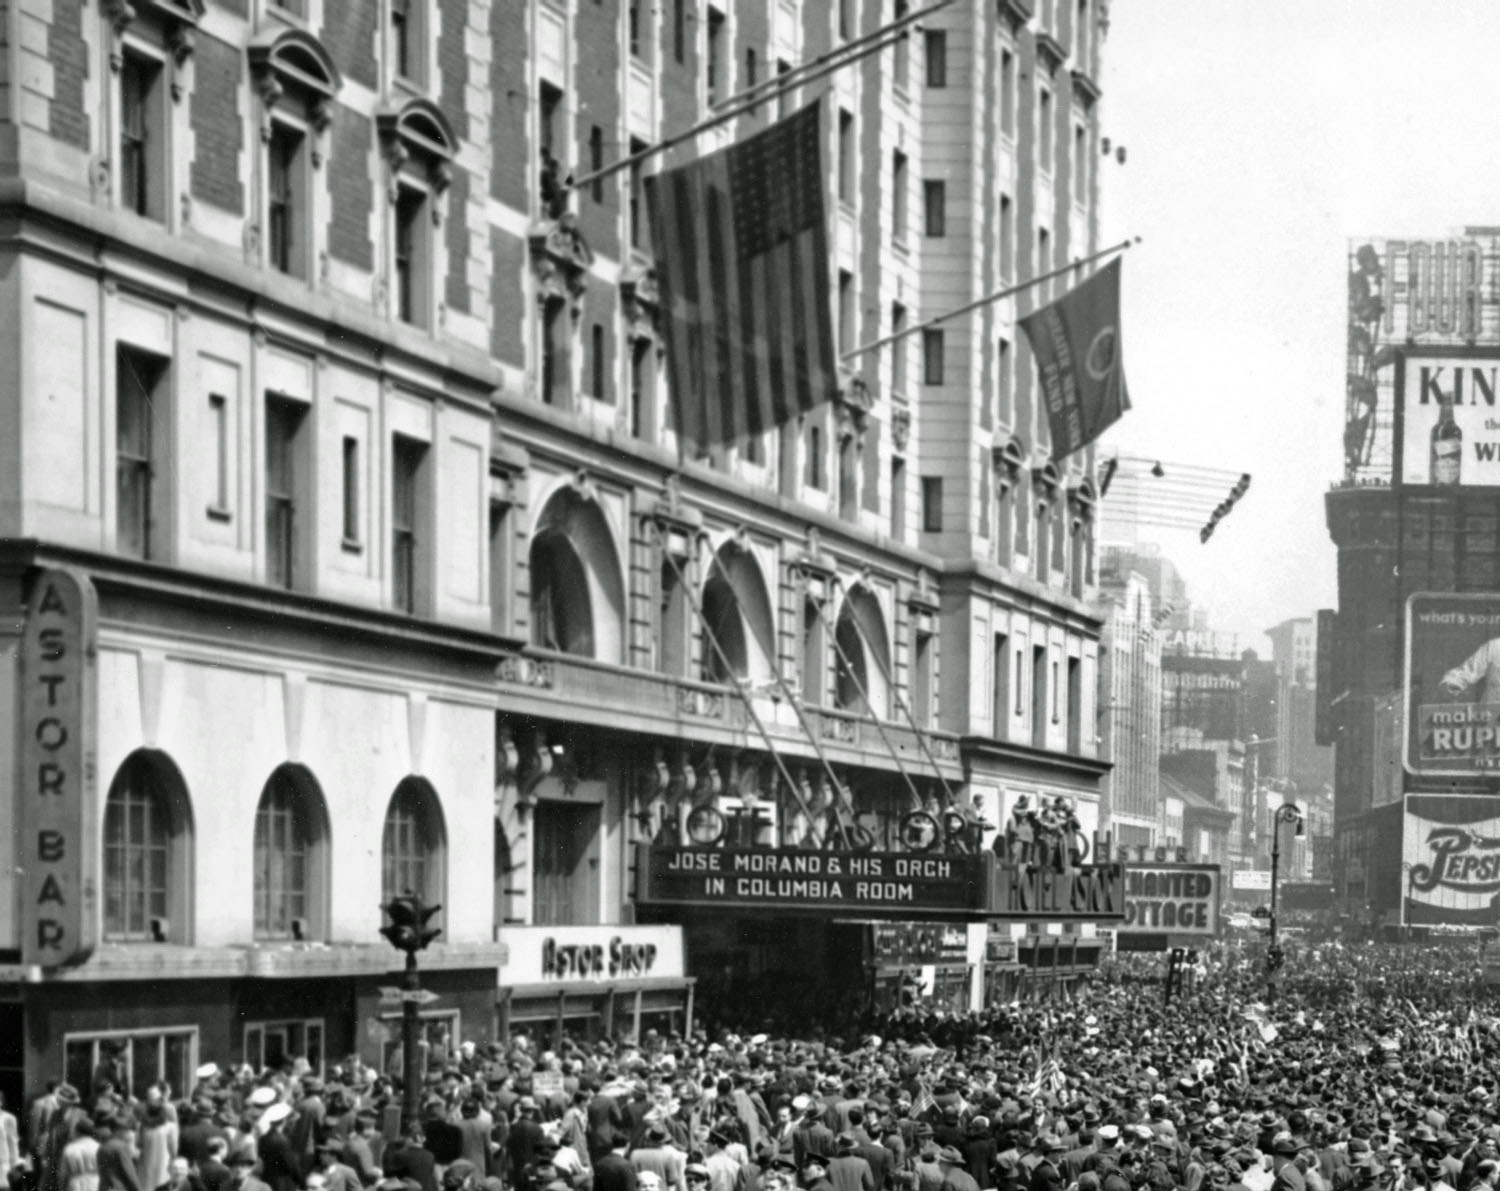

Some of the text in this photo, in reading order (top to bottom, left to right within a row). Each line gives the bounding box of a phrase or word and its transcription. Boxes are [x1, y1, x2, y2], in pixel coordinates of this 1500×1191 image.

[1385, 240, 1483, 336] FOUR
[36, 583, 69, 796] ASTOR
[1432, 707, 1493, 723] make
[668, 852, 721, 871] JOSE
[827, 857, 842, 874] &
[850, 858, 882, 876] HIS
[895, 860, 951, 878] ORCH
[37, 830, 66, 951] BAR
[705, 877, 913, 900] IN COLUMBIA ROOM
[1124, 871, 1213, 899] HANTED
[1123, 901, 1208, 928] OTTAGE
[542, 935, 604, 978] ASTOR
